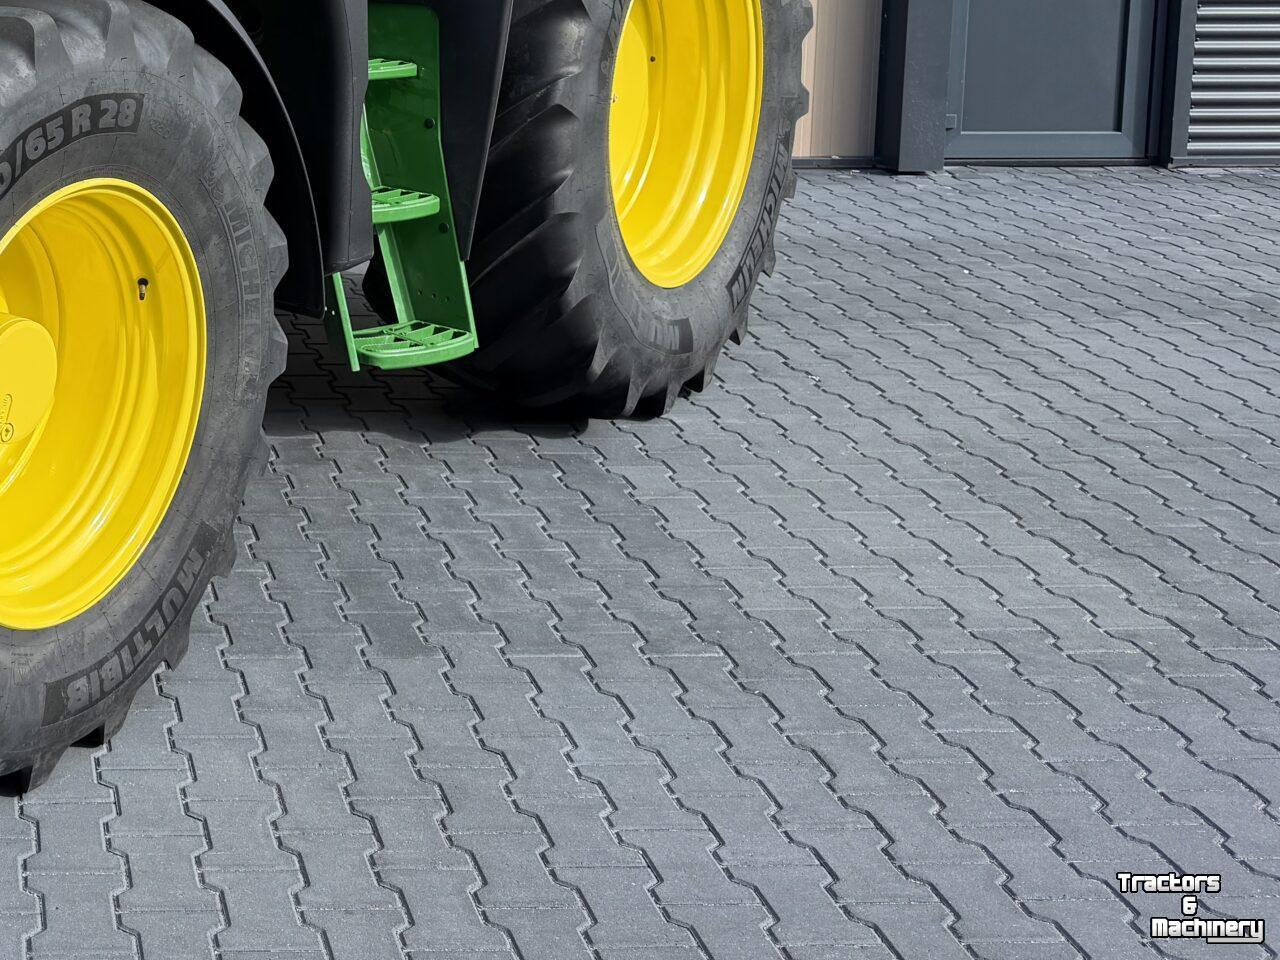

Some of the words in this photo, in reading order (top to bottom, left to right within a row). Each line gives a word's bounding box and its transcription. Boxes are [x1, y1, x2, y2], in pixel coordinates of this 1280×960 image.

[72, 103, 91, 138] R
[98, 98, 138, 129] 28
[731, 142, 789, 310] MICHELIN
[66, 547, 207, 712] MULTIBIB
